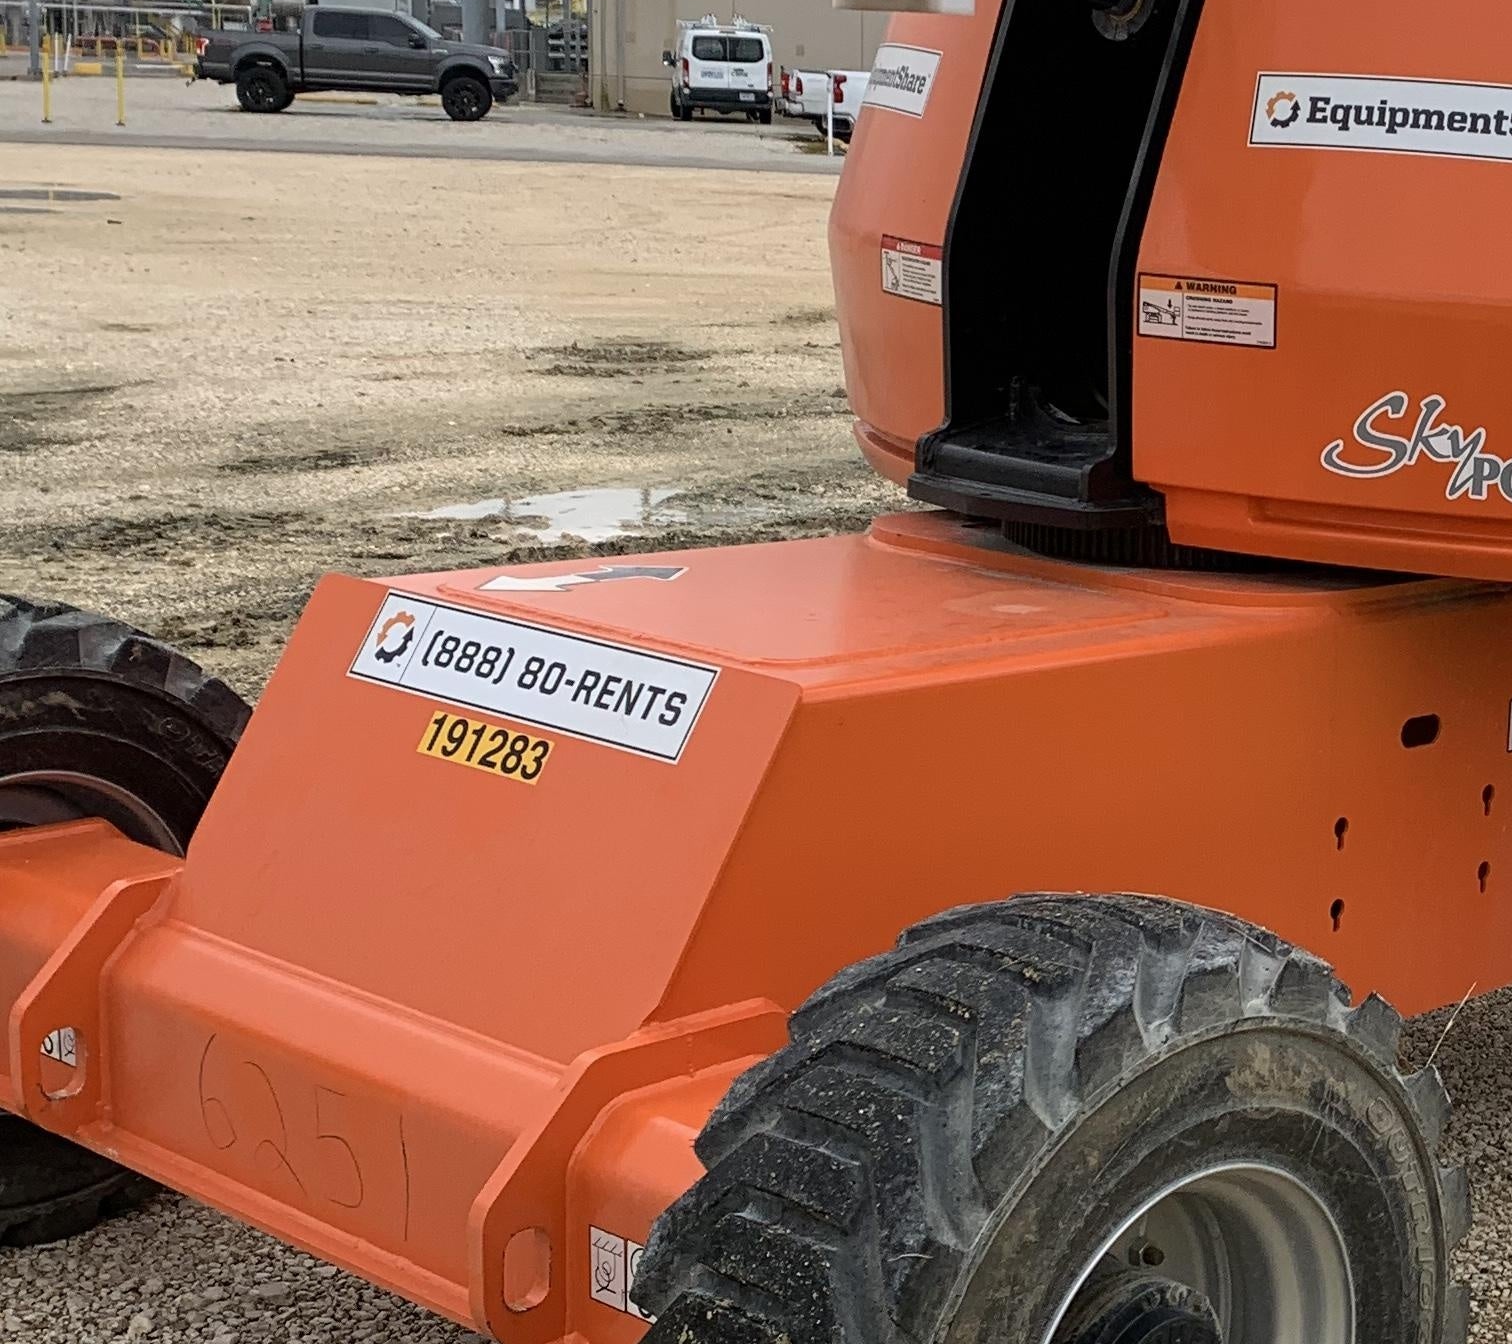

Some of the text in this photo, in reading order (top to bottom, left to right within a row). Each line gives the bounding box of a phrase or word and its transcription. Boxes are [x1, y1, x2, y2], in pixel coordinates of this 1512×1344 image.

[1186, 281, 1237, 295] WARNING
[420, 628, 689, 727] (888) 80-RENTS
[423, 715, 551, 781] 191283
